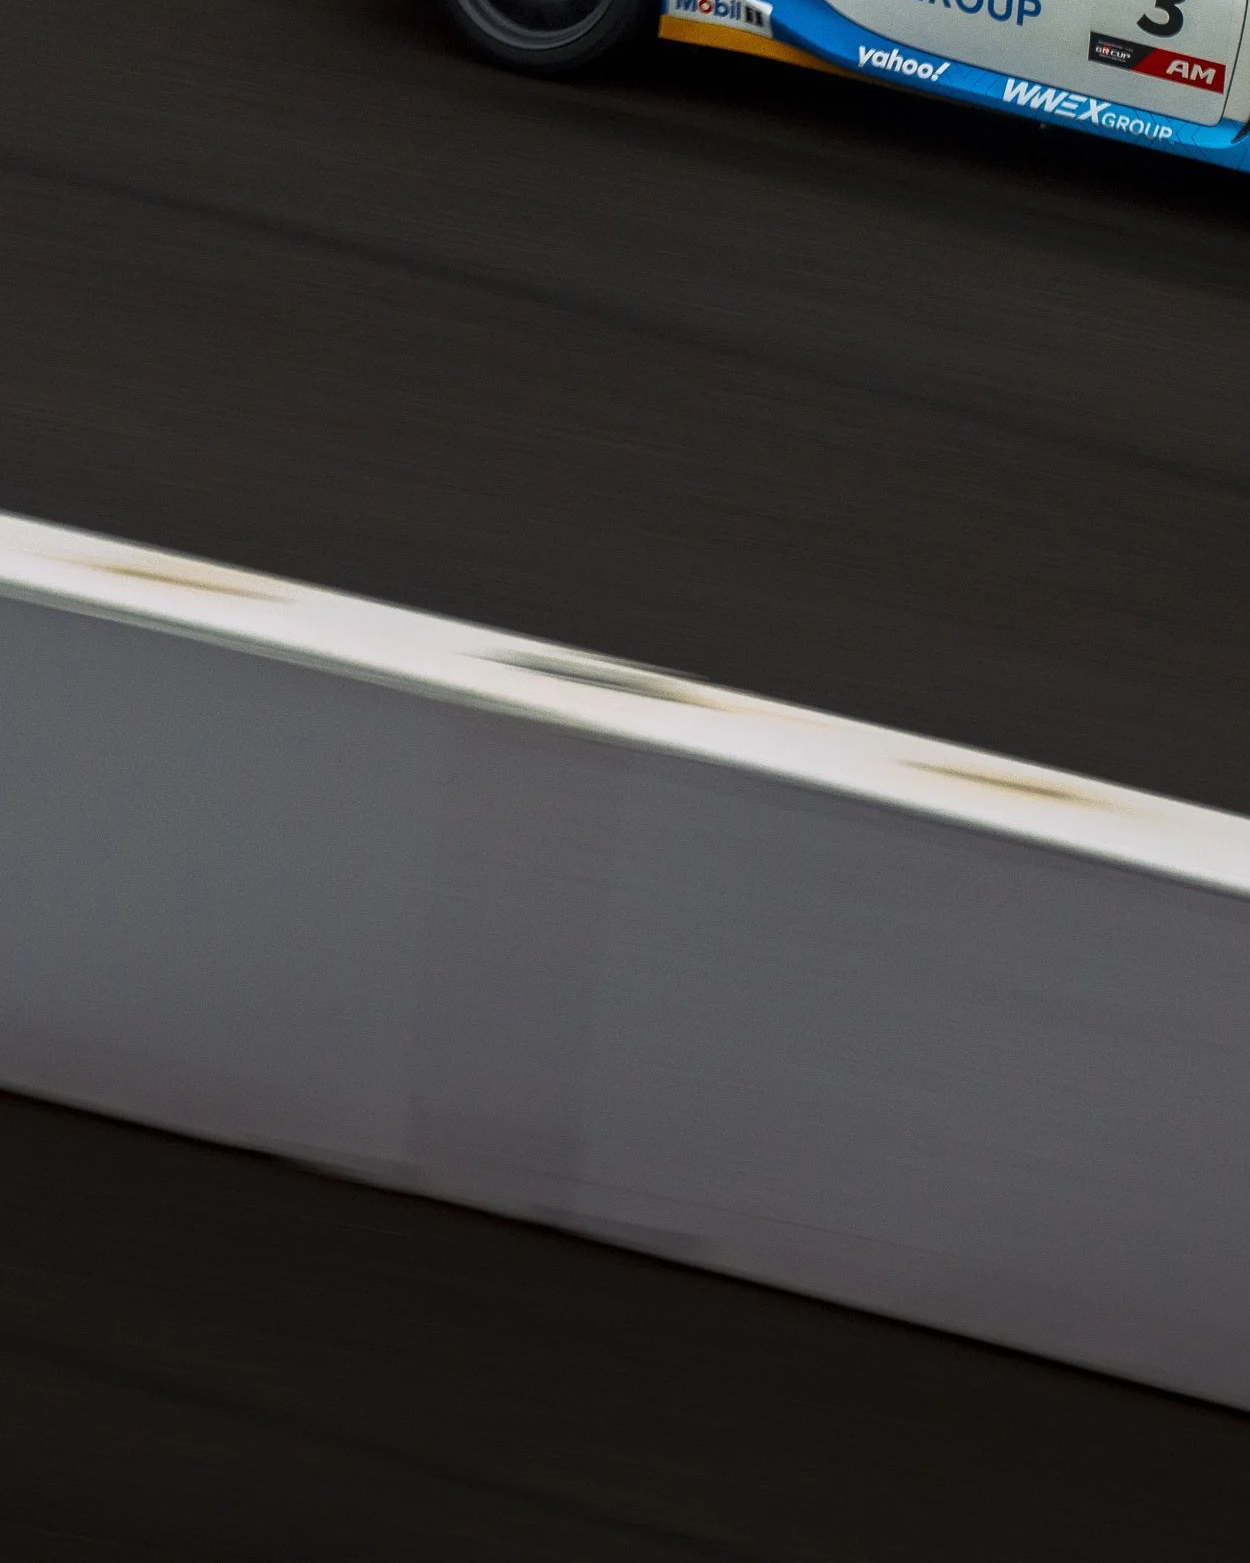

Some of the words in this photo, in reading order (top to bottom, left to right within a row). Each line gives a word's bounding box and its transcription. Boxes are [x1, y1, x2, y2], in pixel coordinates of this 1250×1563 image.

[858, 45, 951, 82] yahoo!
[1166, 59, 1216, 85] AM
[1102, 112, 1173, 141] GROUP
